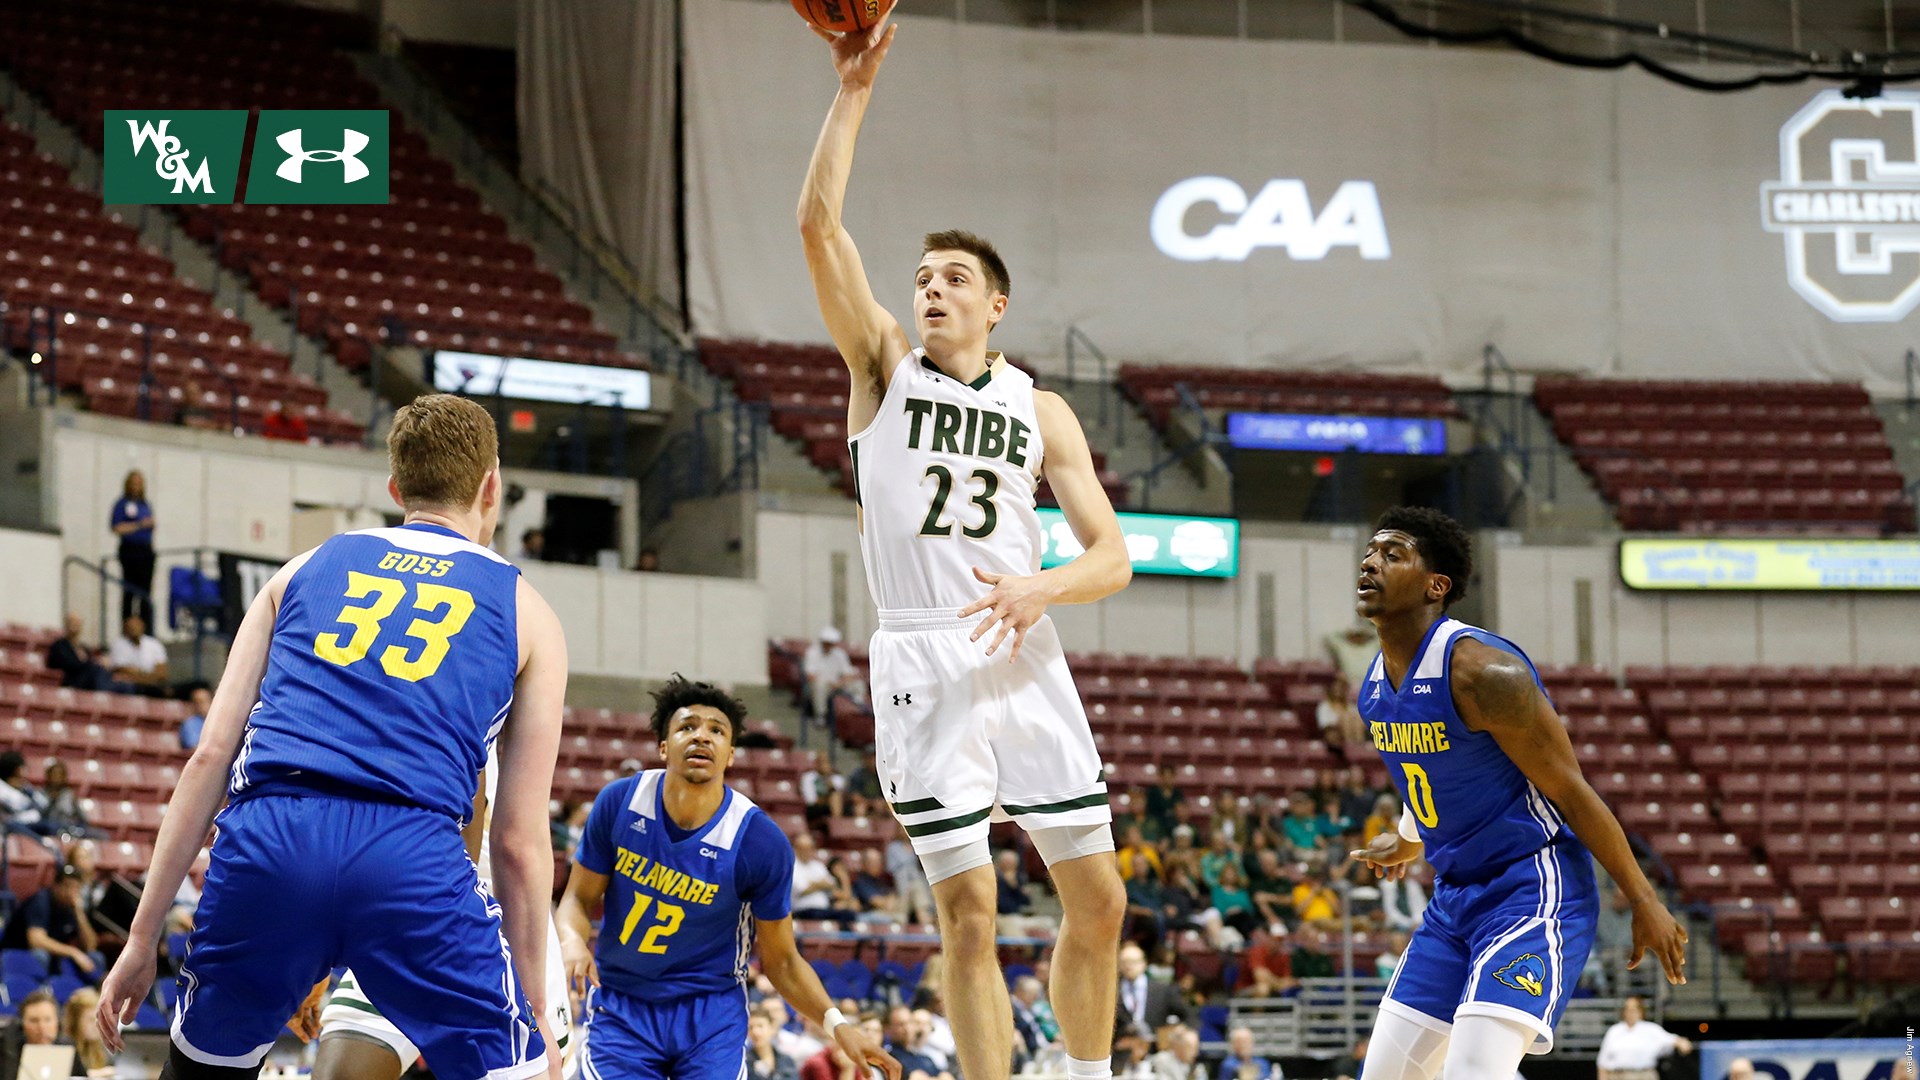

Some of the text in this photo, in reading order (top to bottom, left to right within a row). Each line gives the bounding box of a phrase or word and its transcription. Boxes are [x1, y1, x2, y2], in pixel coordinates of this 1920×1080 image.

[1149, 175, 1392, 261] CAA
[904, 397, 1032, 469] TRIBE
[918, 463, 1000, 540] 23
[378, 551, 455, 577] GOSS
[313, 571, 476, 683] 33
[1412, 684, 1432, 694] CAA
[1369, 720, 1450, 754] DELAWARE
[1400, 762, 1439, 829] 0
[614, 846, 720, 905] DELAWARE
[618, 890, 686, 955] 12
